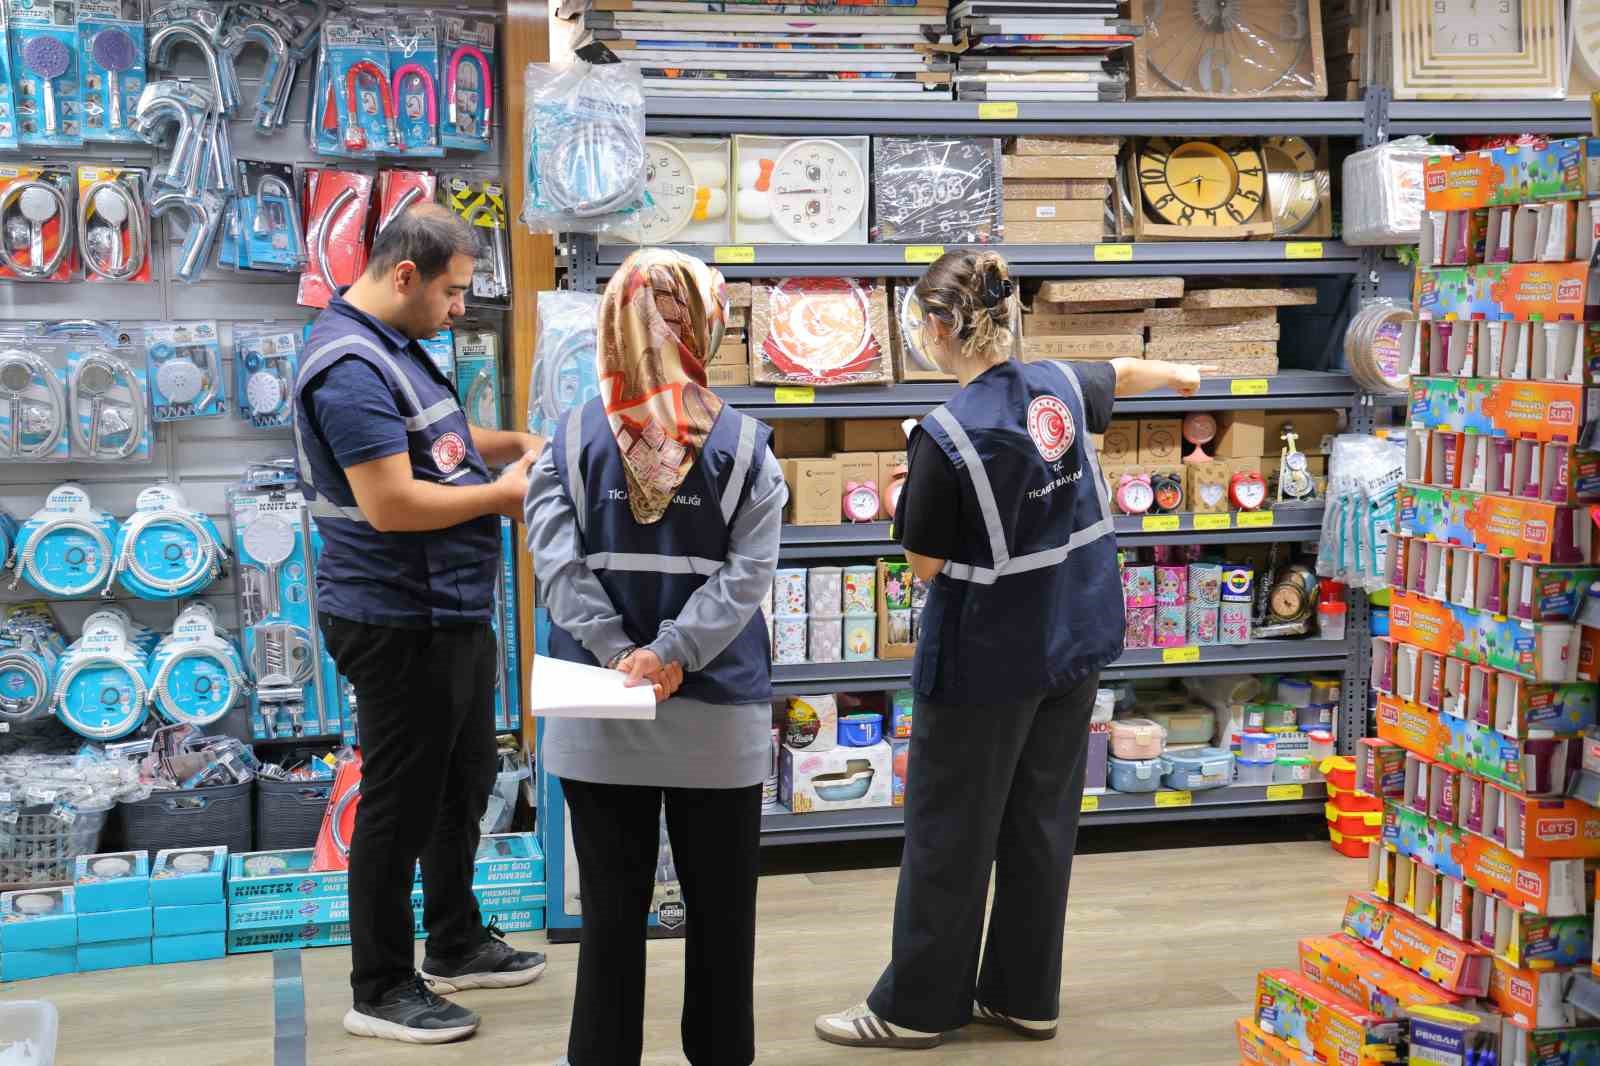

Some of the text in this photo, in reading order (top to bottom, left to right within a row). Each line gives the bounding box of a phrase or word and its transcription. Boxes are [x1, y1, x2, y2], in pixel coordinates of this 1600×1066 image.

[1027, 464, 1083, 500] TİCARET BAKAN
[607, 488, 702, 507] TİC NLIĞI
[258, 502, 298, 511] KNITEX
[234, 882, 294, 897] KINETEX
[235, 931, 294, 947] KINETEX
[1414, 1028, 1460, 1047] PENSAN
